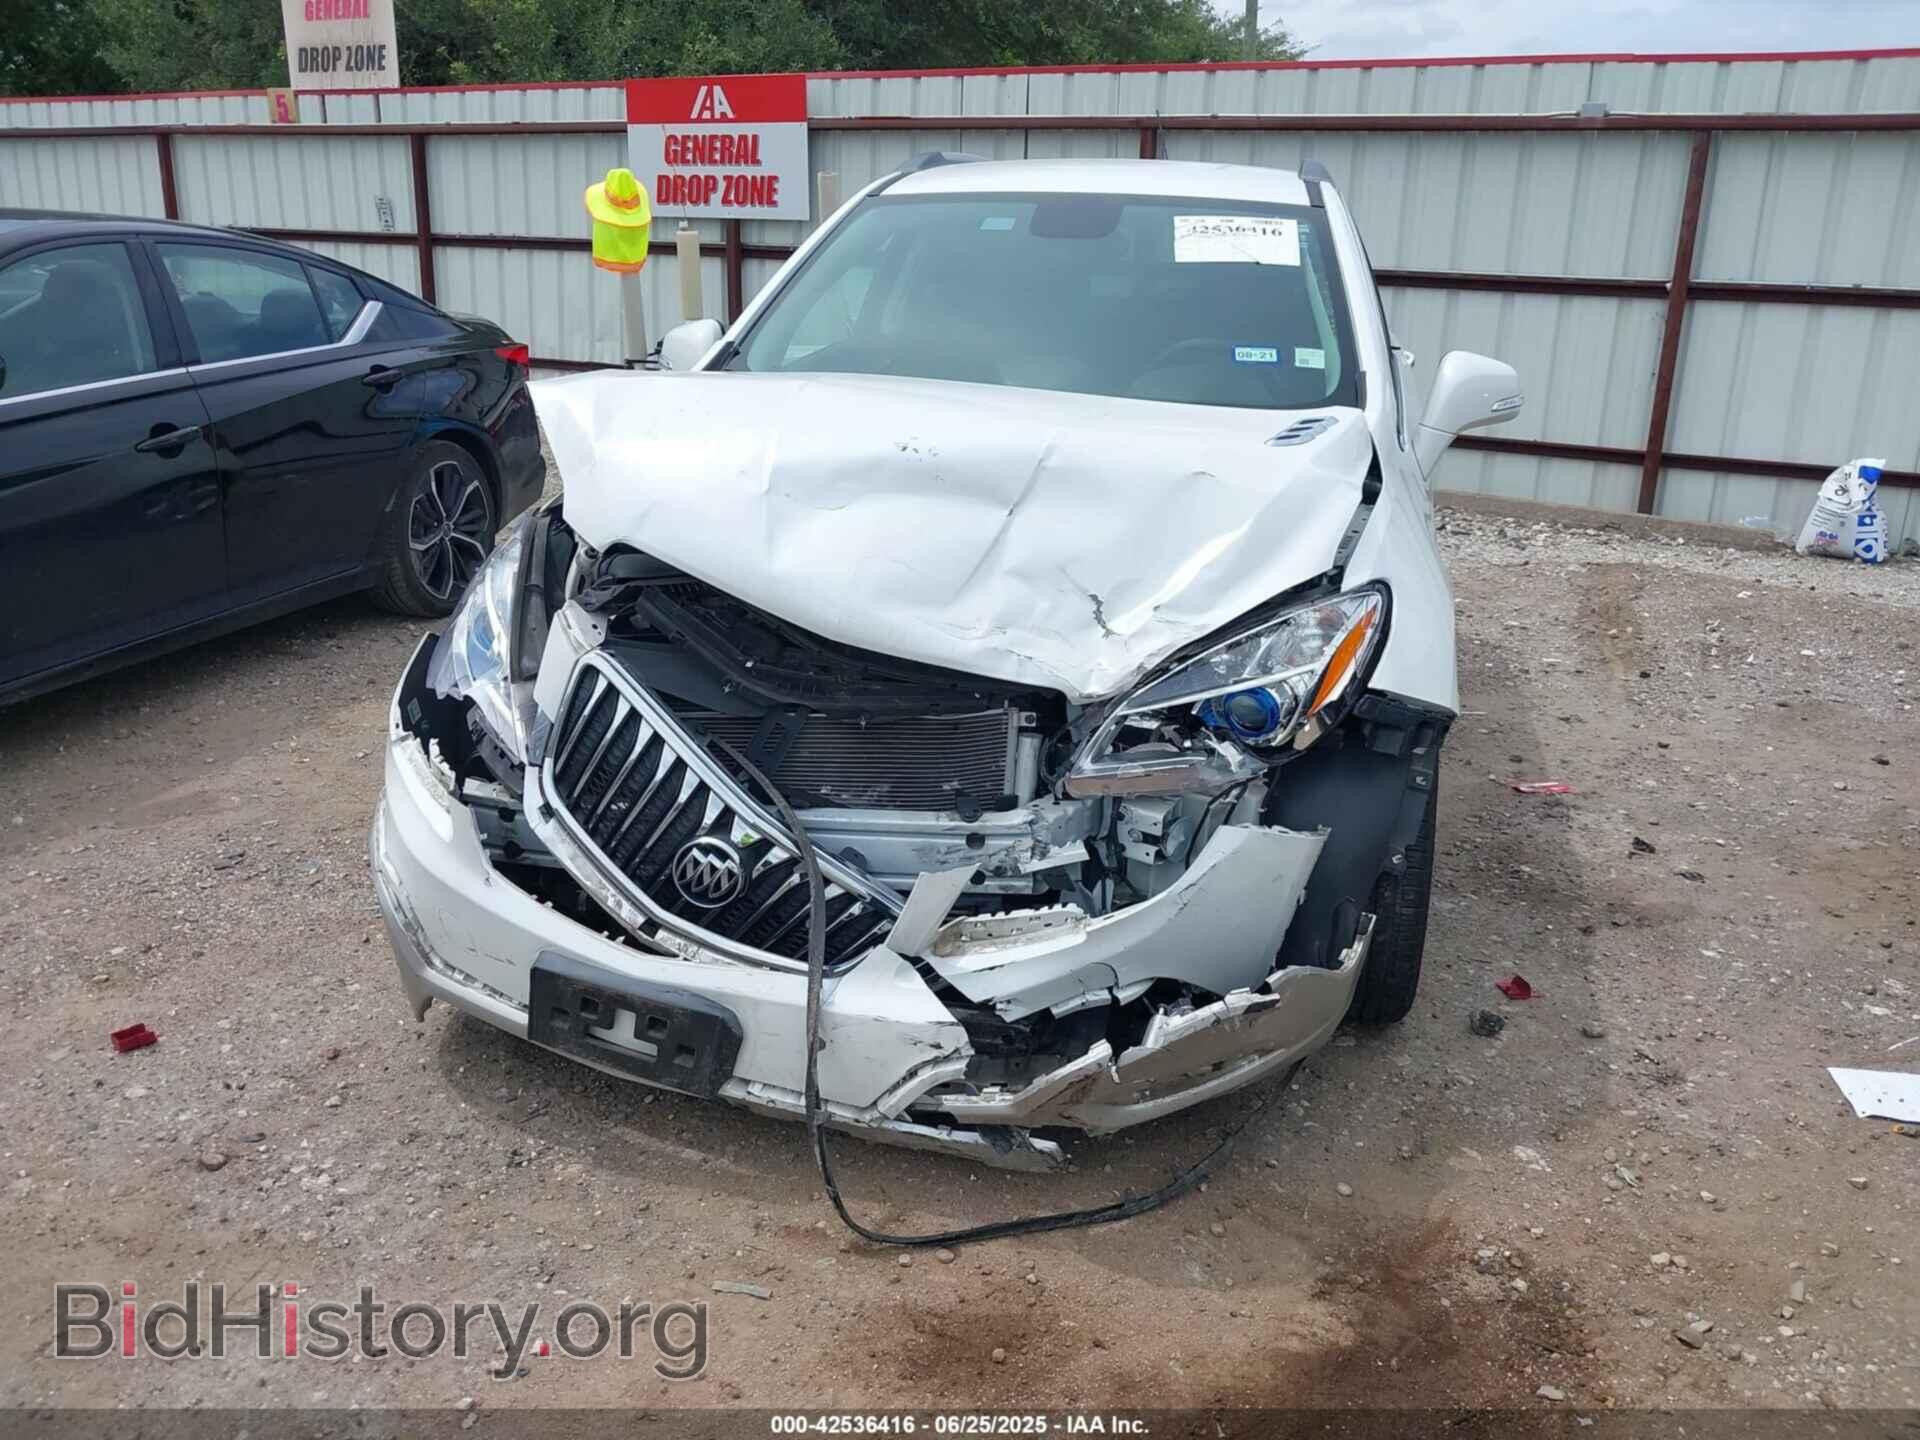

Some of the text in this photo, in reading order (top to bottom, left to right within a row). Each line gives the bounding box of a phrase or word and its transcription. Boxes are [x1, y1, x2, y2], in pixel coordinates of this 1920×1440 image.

[304, 0, 369, 21] GENERAL
[298, 43, 386, 73] DROP ZONE
[664, 134, 762, 166] GENERAL
[656, 174, 780, 207] DROP ZONE
